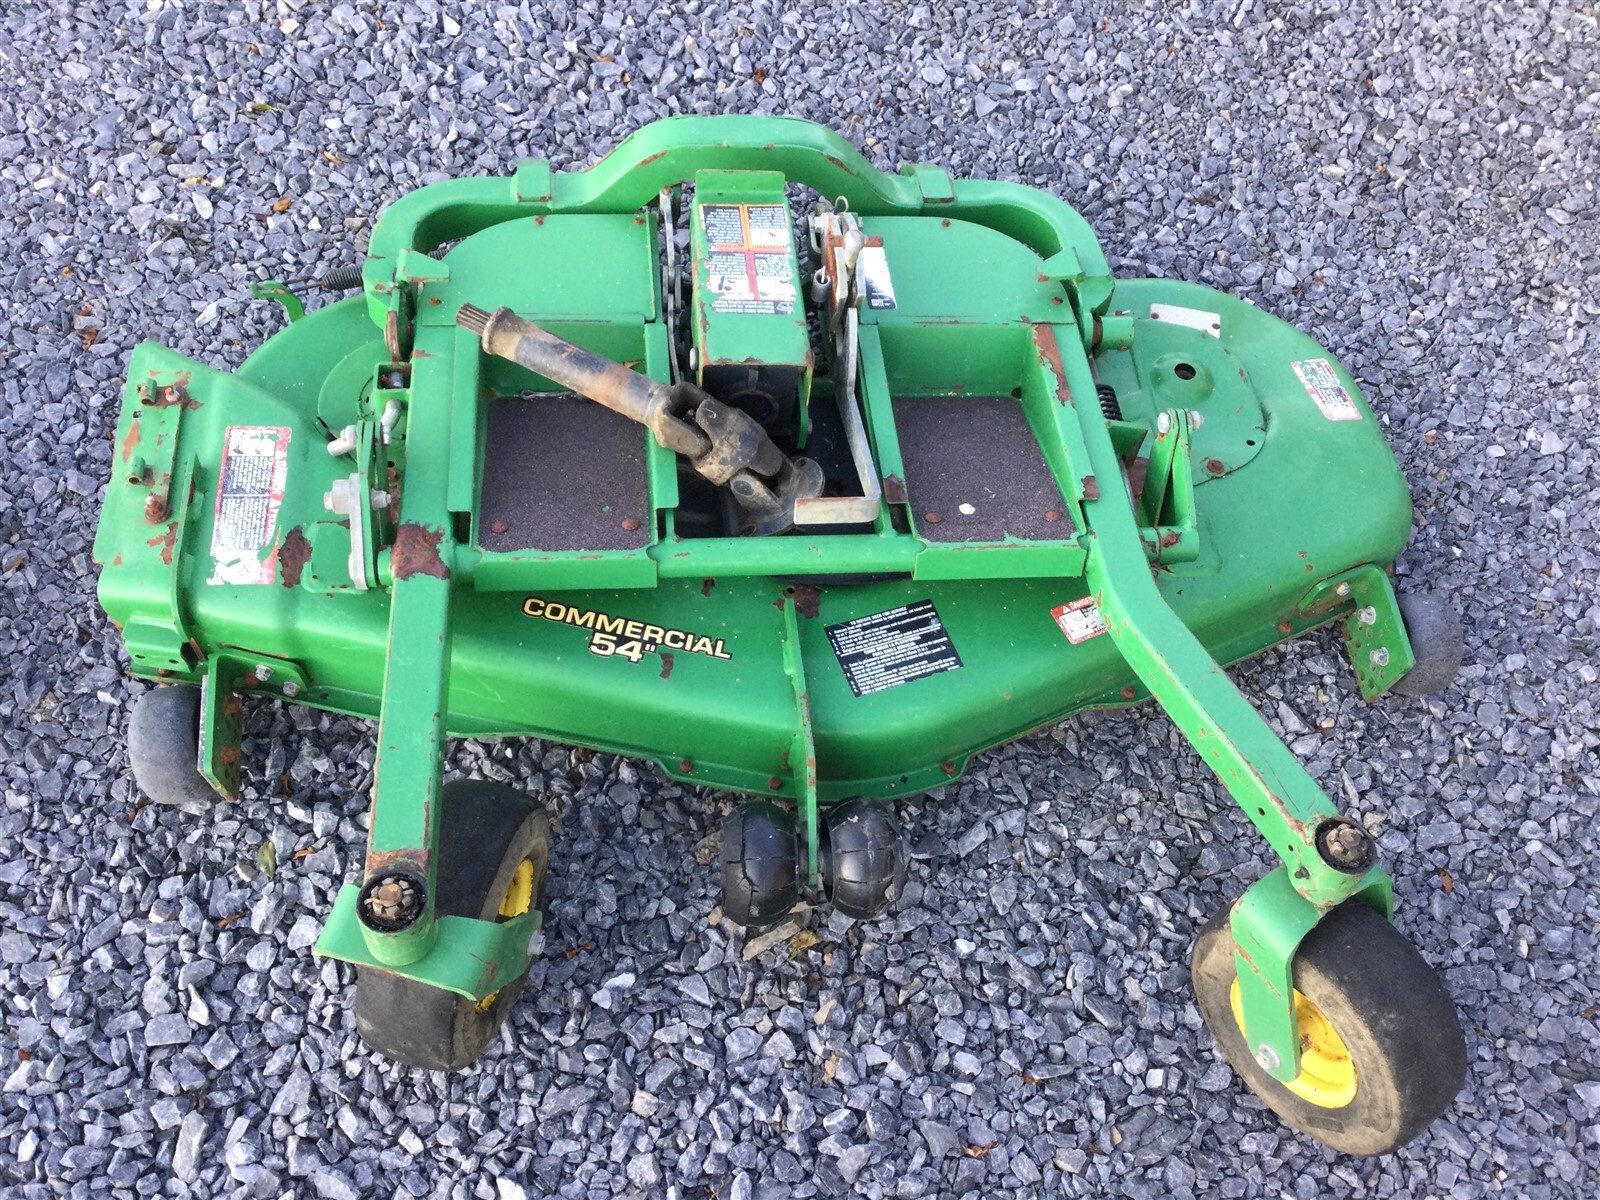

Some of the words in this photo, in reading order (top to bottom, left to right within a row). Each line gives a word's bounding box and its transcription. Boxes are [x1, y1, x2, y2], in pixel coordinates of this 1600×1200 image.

[891, 606, 907, 614] SERVICE
[1069, 596, 1094, 610] DANGER
[523, 598, 732, 660] COMMERCIAL
